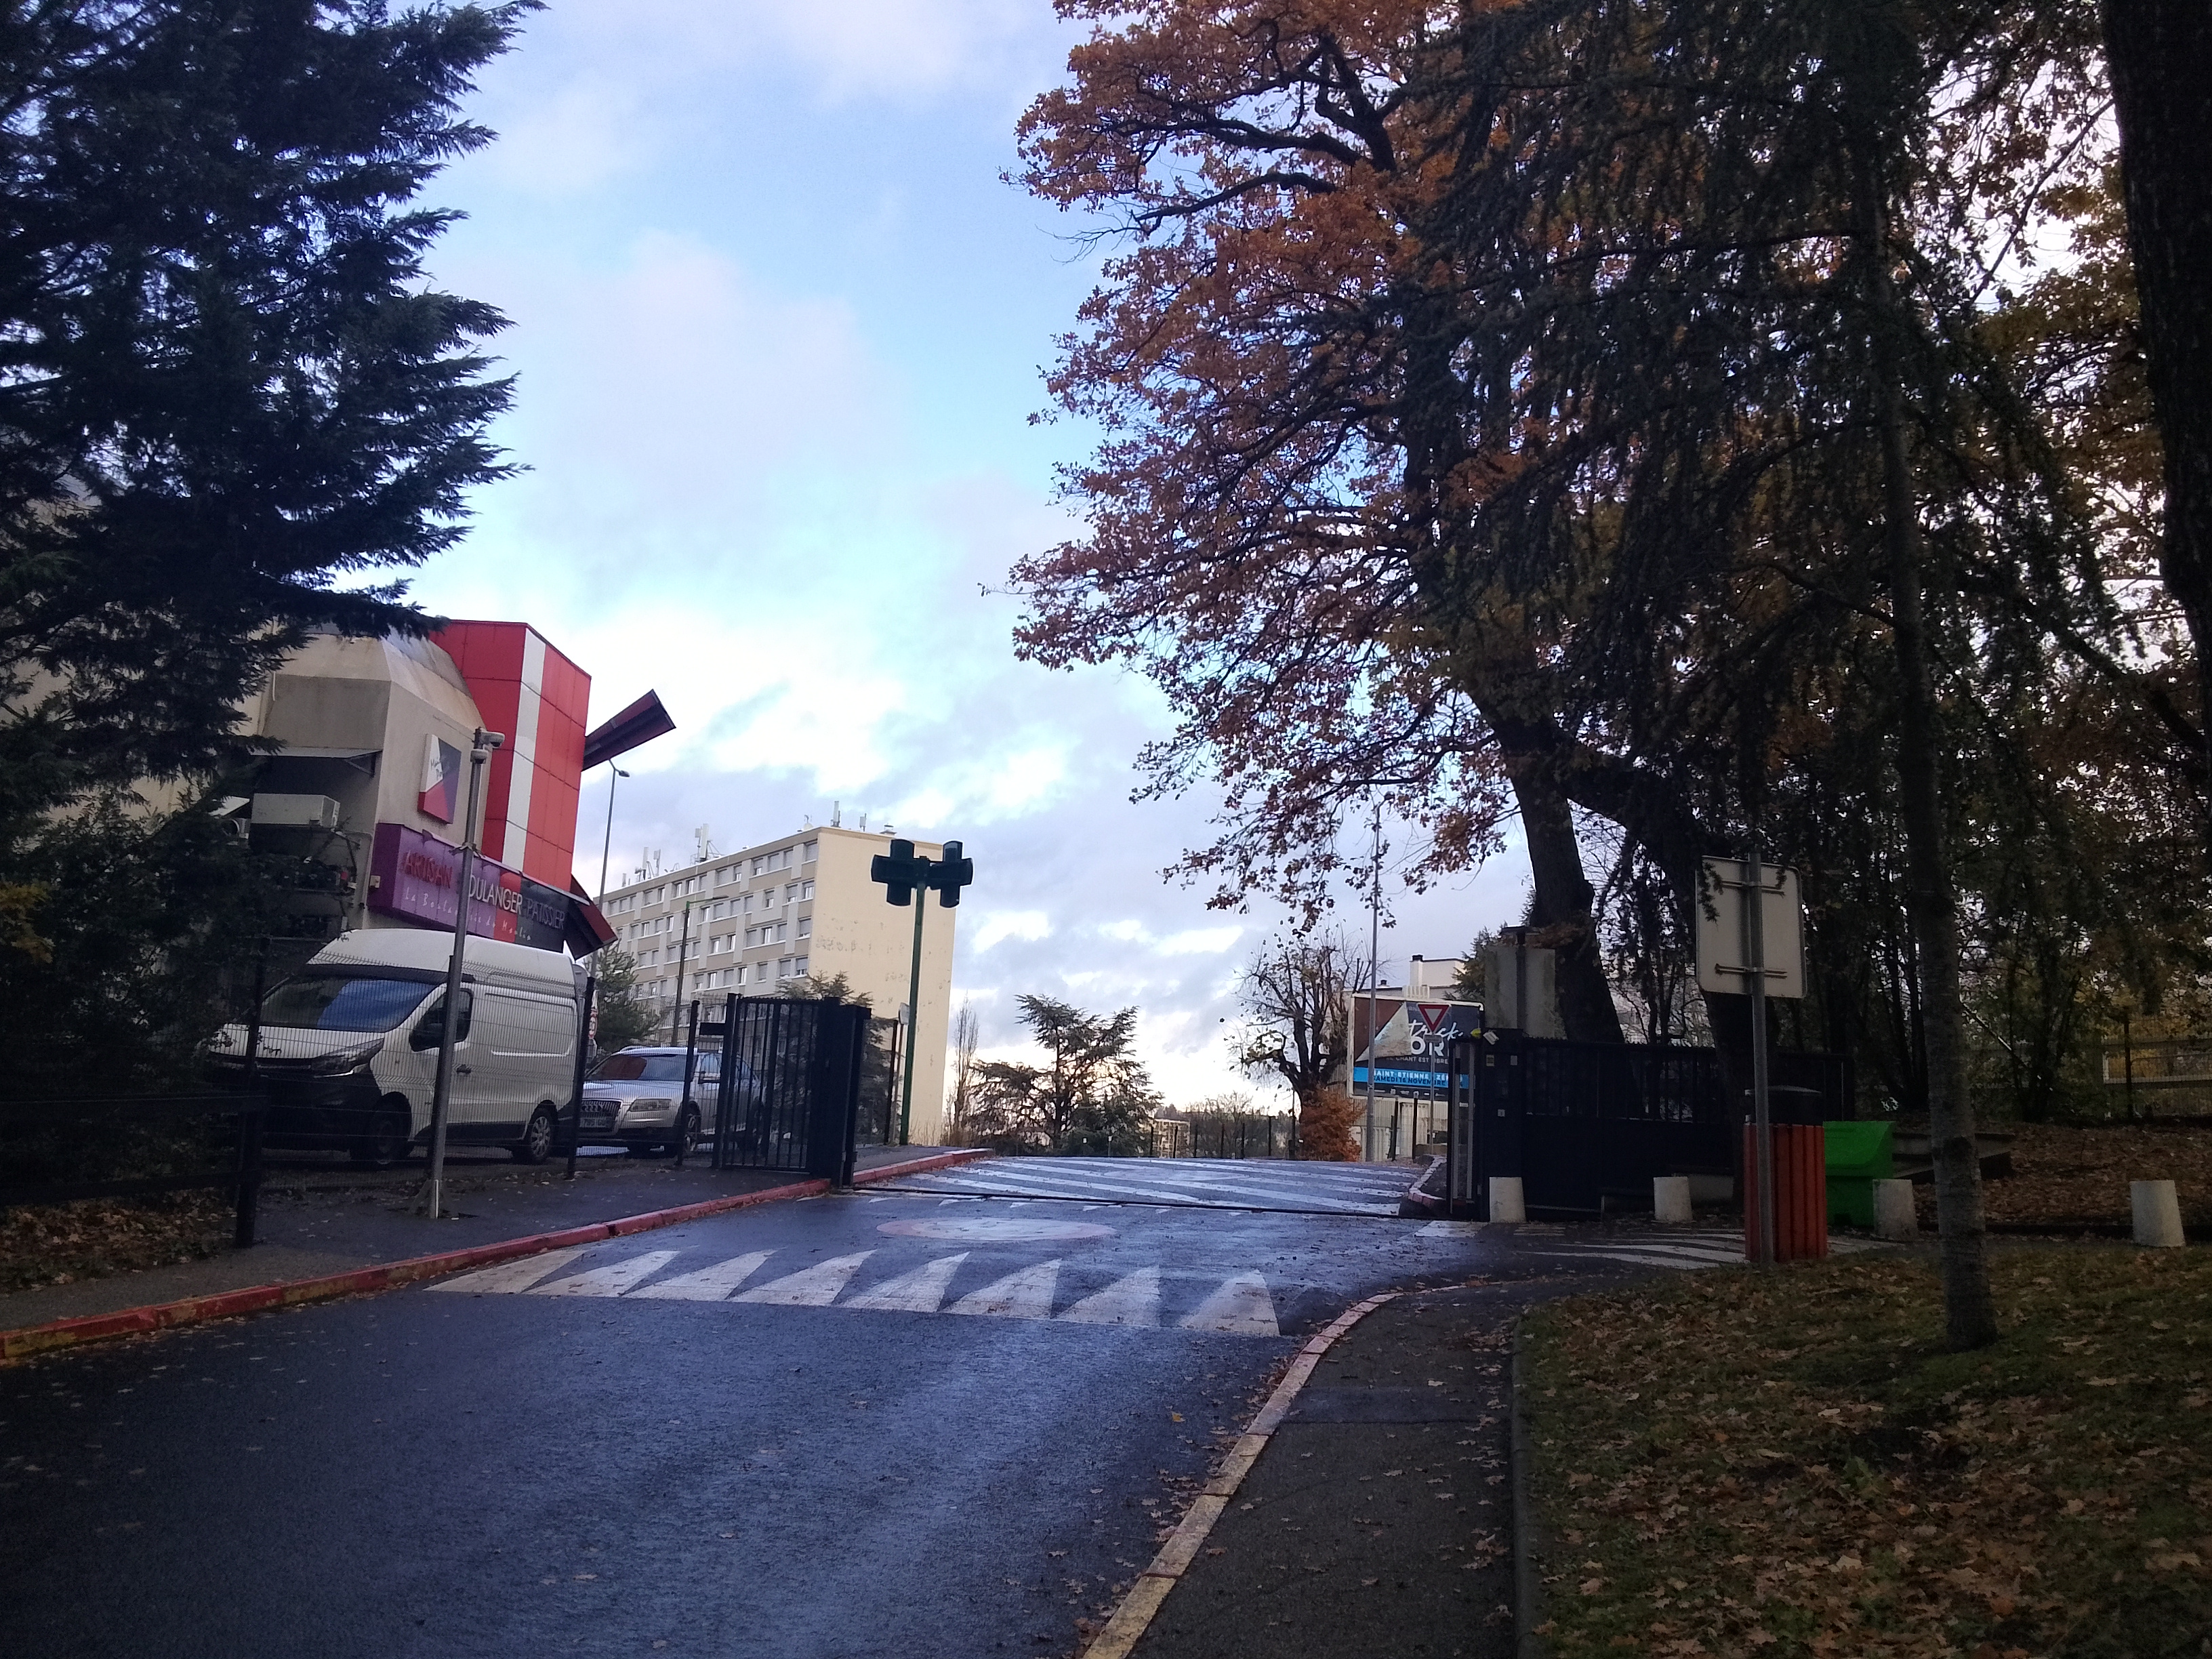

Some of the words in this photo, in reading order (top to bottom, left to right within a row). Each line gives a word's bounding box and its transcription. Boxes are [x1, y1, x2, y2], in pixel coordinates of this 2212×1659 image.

[403, 851, 453, 889] ARTISAN
[468, 874, 523, 915] OULANGER
[527, 897, 566, 930] PATISSIER
[405, 886, 415, 901] La
